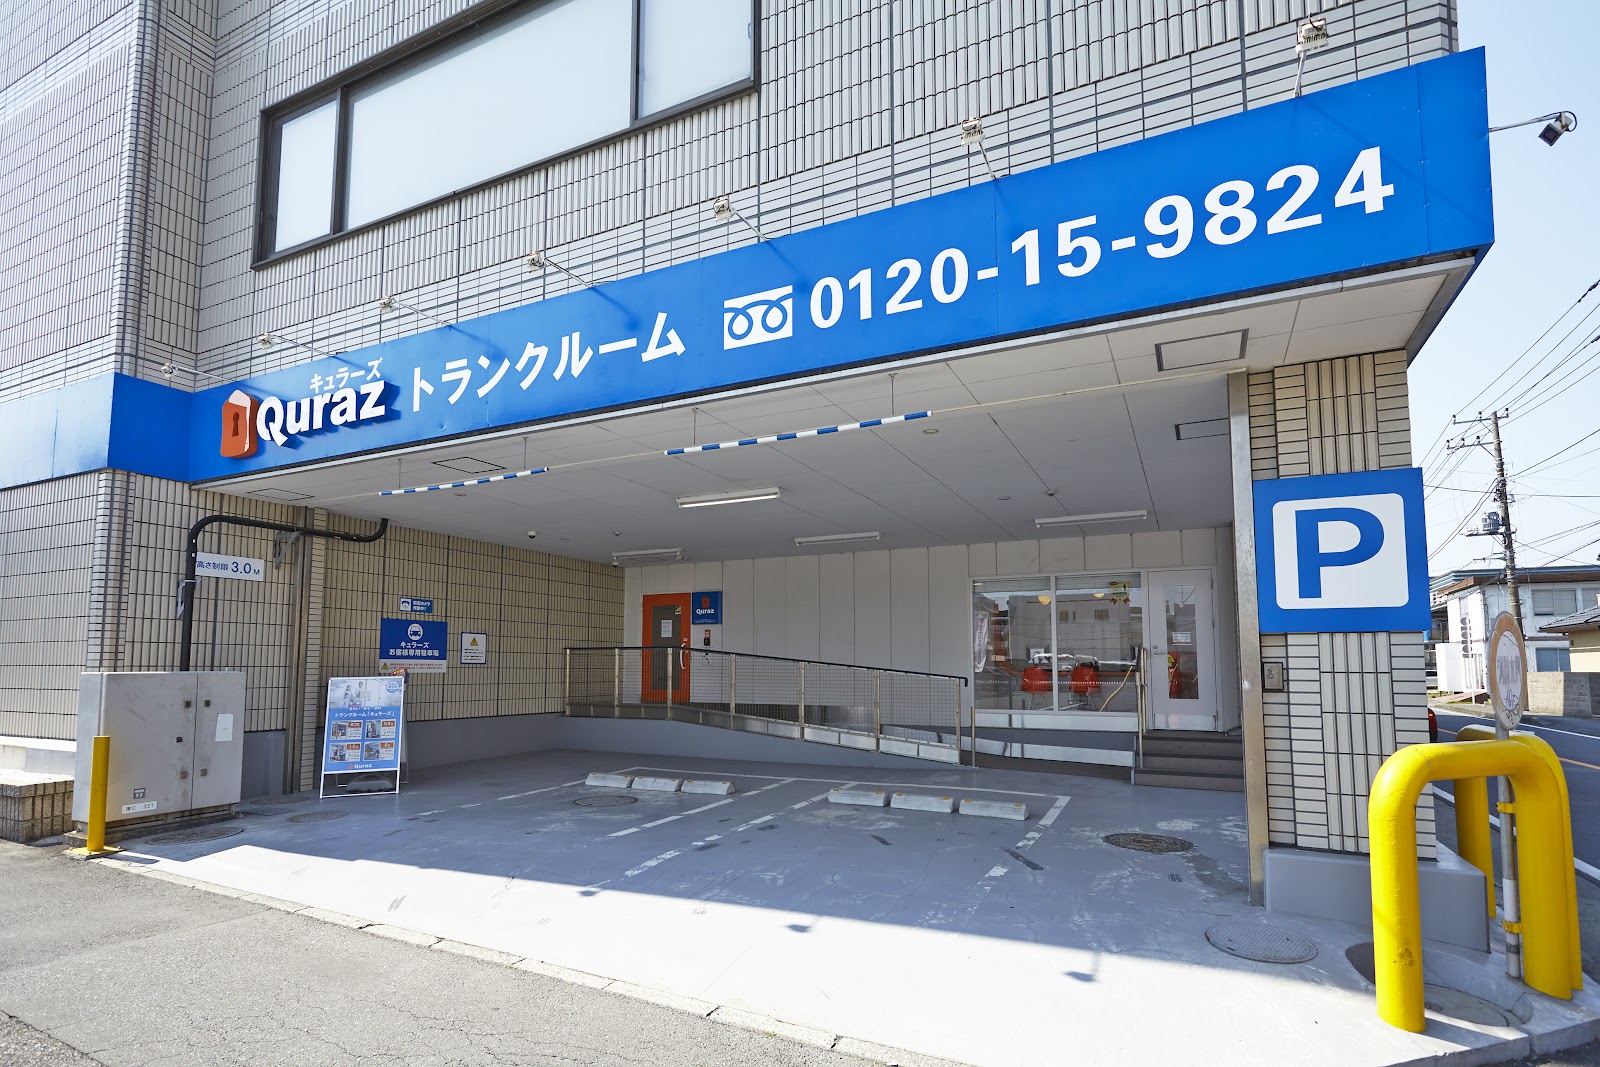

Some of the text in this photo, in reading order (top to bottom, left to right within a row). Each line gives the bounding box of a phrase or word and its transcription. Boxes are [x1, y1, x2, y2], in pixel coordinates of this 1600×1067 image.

[809, 147, 1394, 329] 0120-15-9824
[310, 356, 383, 392] キュラーズ
[413, 312, 685, 412] トランクルーム
[256, 380, 386, 447] Quraz
[1295, 507, 1385, 599] P
